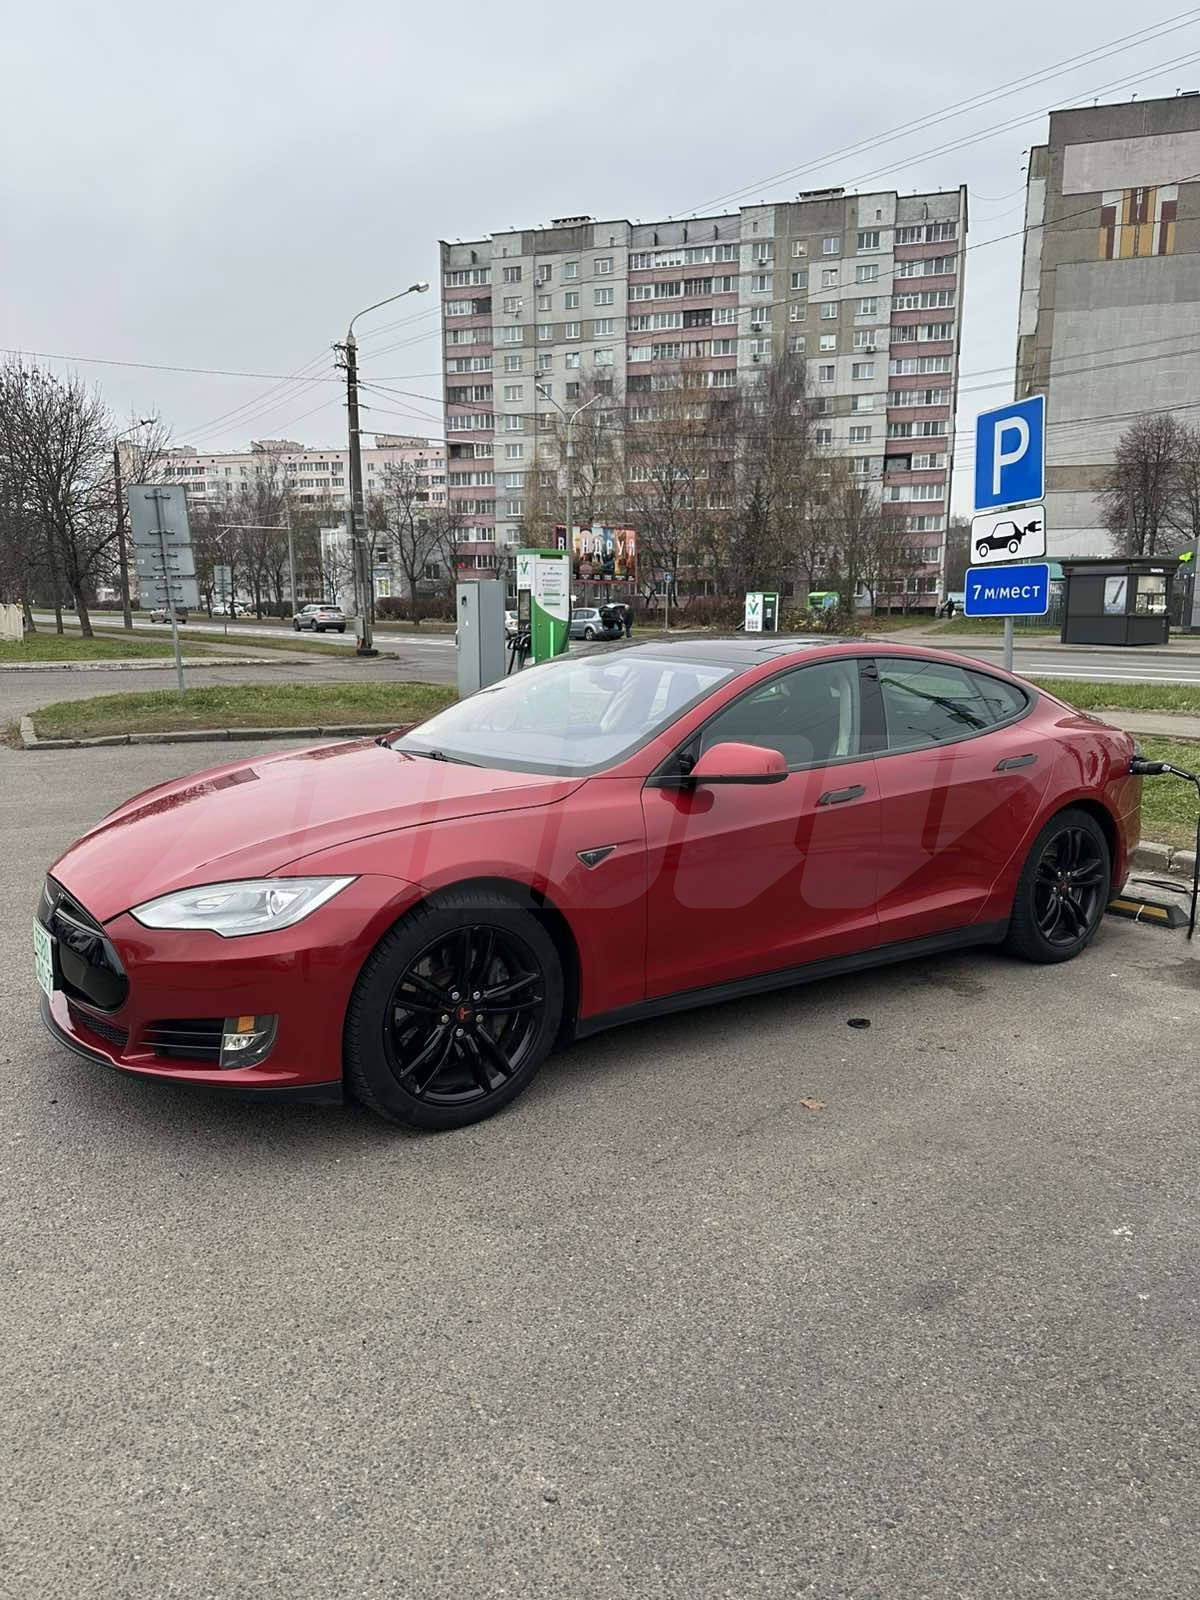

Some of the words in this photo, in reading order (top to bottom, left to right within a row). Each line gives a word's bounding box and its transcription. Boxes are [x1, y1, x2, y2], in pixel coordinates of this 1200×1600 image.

[992, 416, 1030, 495] P
[973, 584, 982, 600] 7
[984, 585, 1040, 600] м/мест
